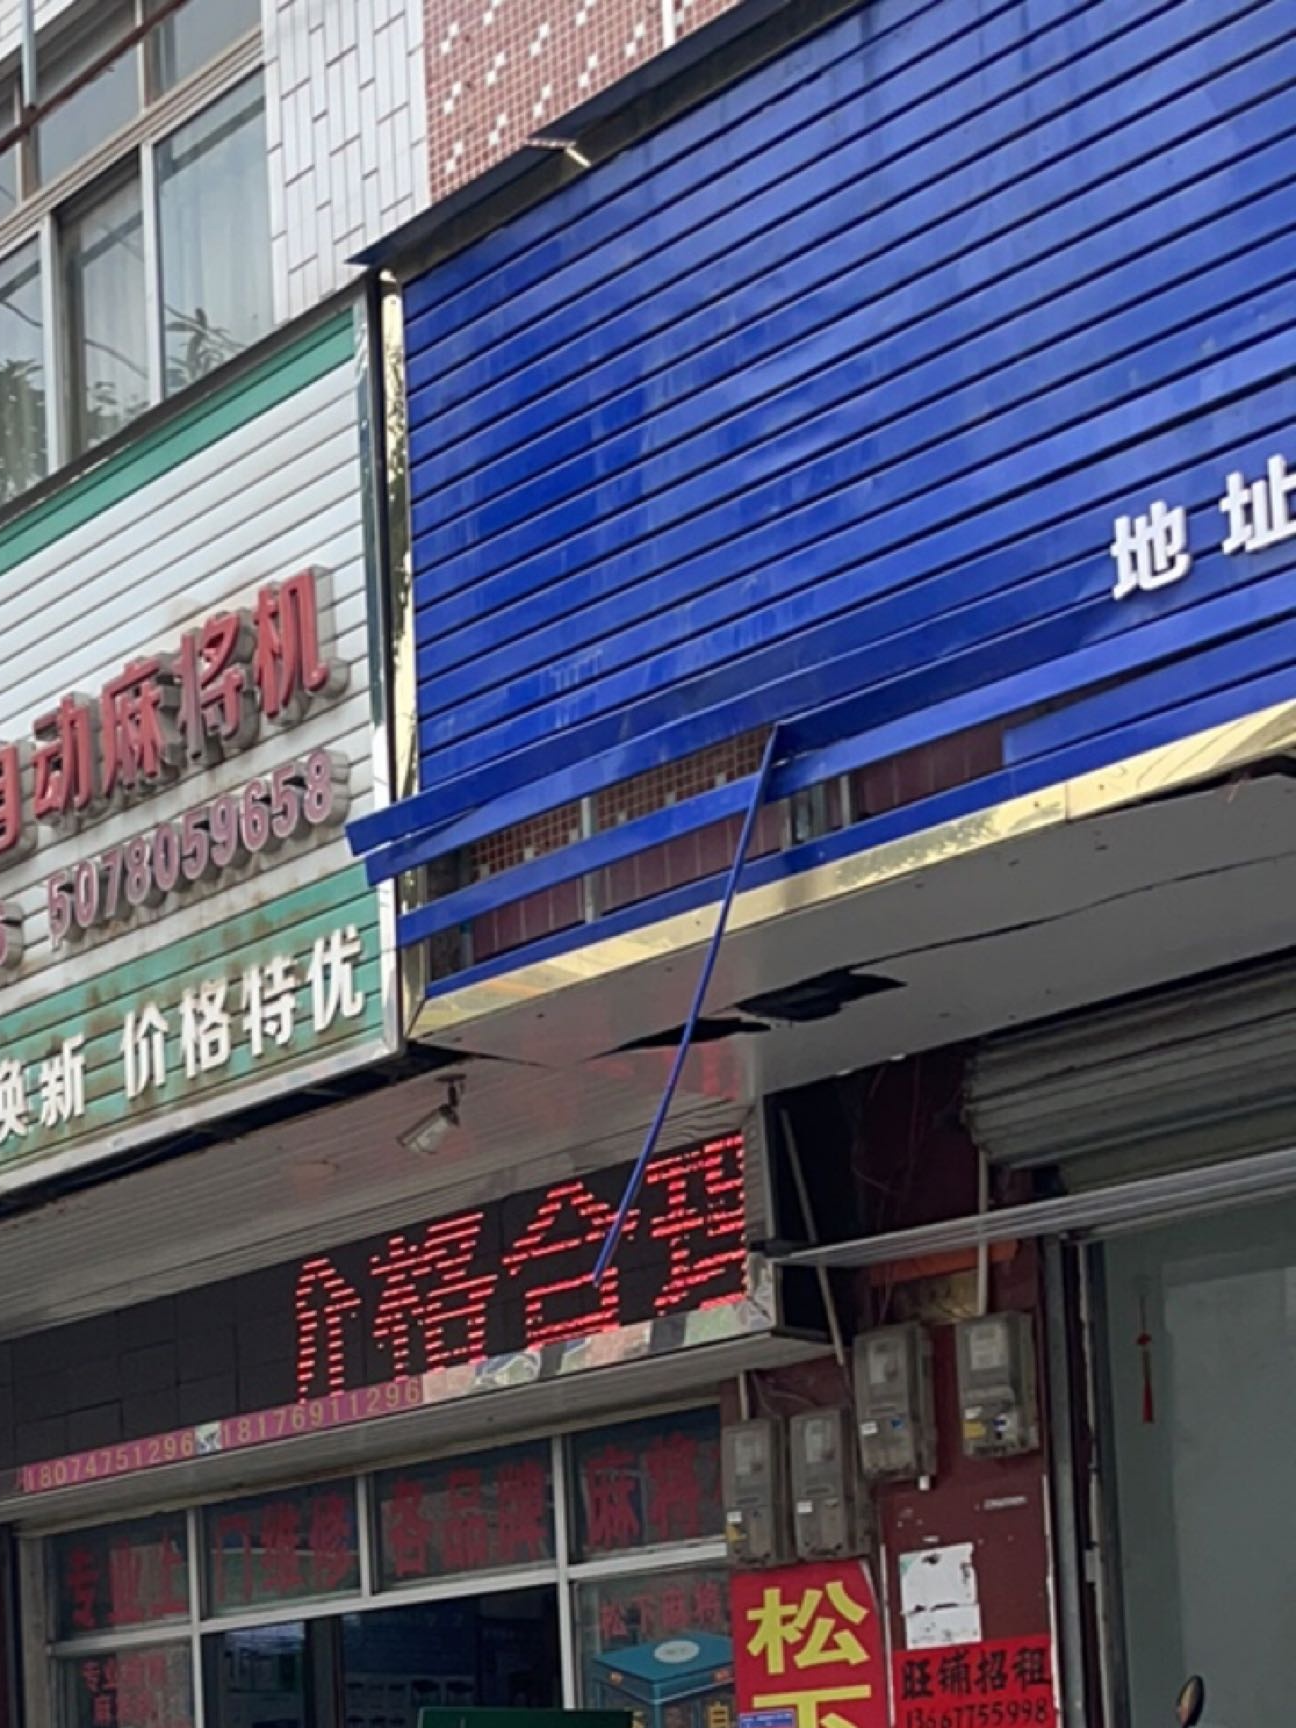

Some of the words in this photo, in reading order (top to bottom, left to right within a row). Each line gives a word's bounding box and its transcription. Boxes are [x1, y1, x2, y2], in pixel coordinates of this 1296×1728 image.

[1110, 453, 1296, 600] 地址
[120, 928, 365, 1100] 价格特优
[28, 1429, 194, 1491] 18074751296
[221, 1380, 422, 1448] 18176911296
